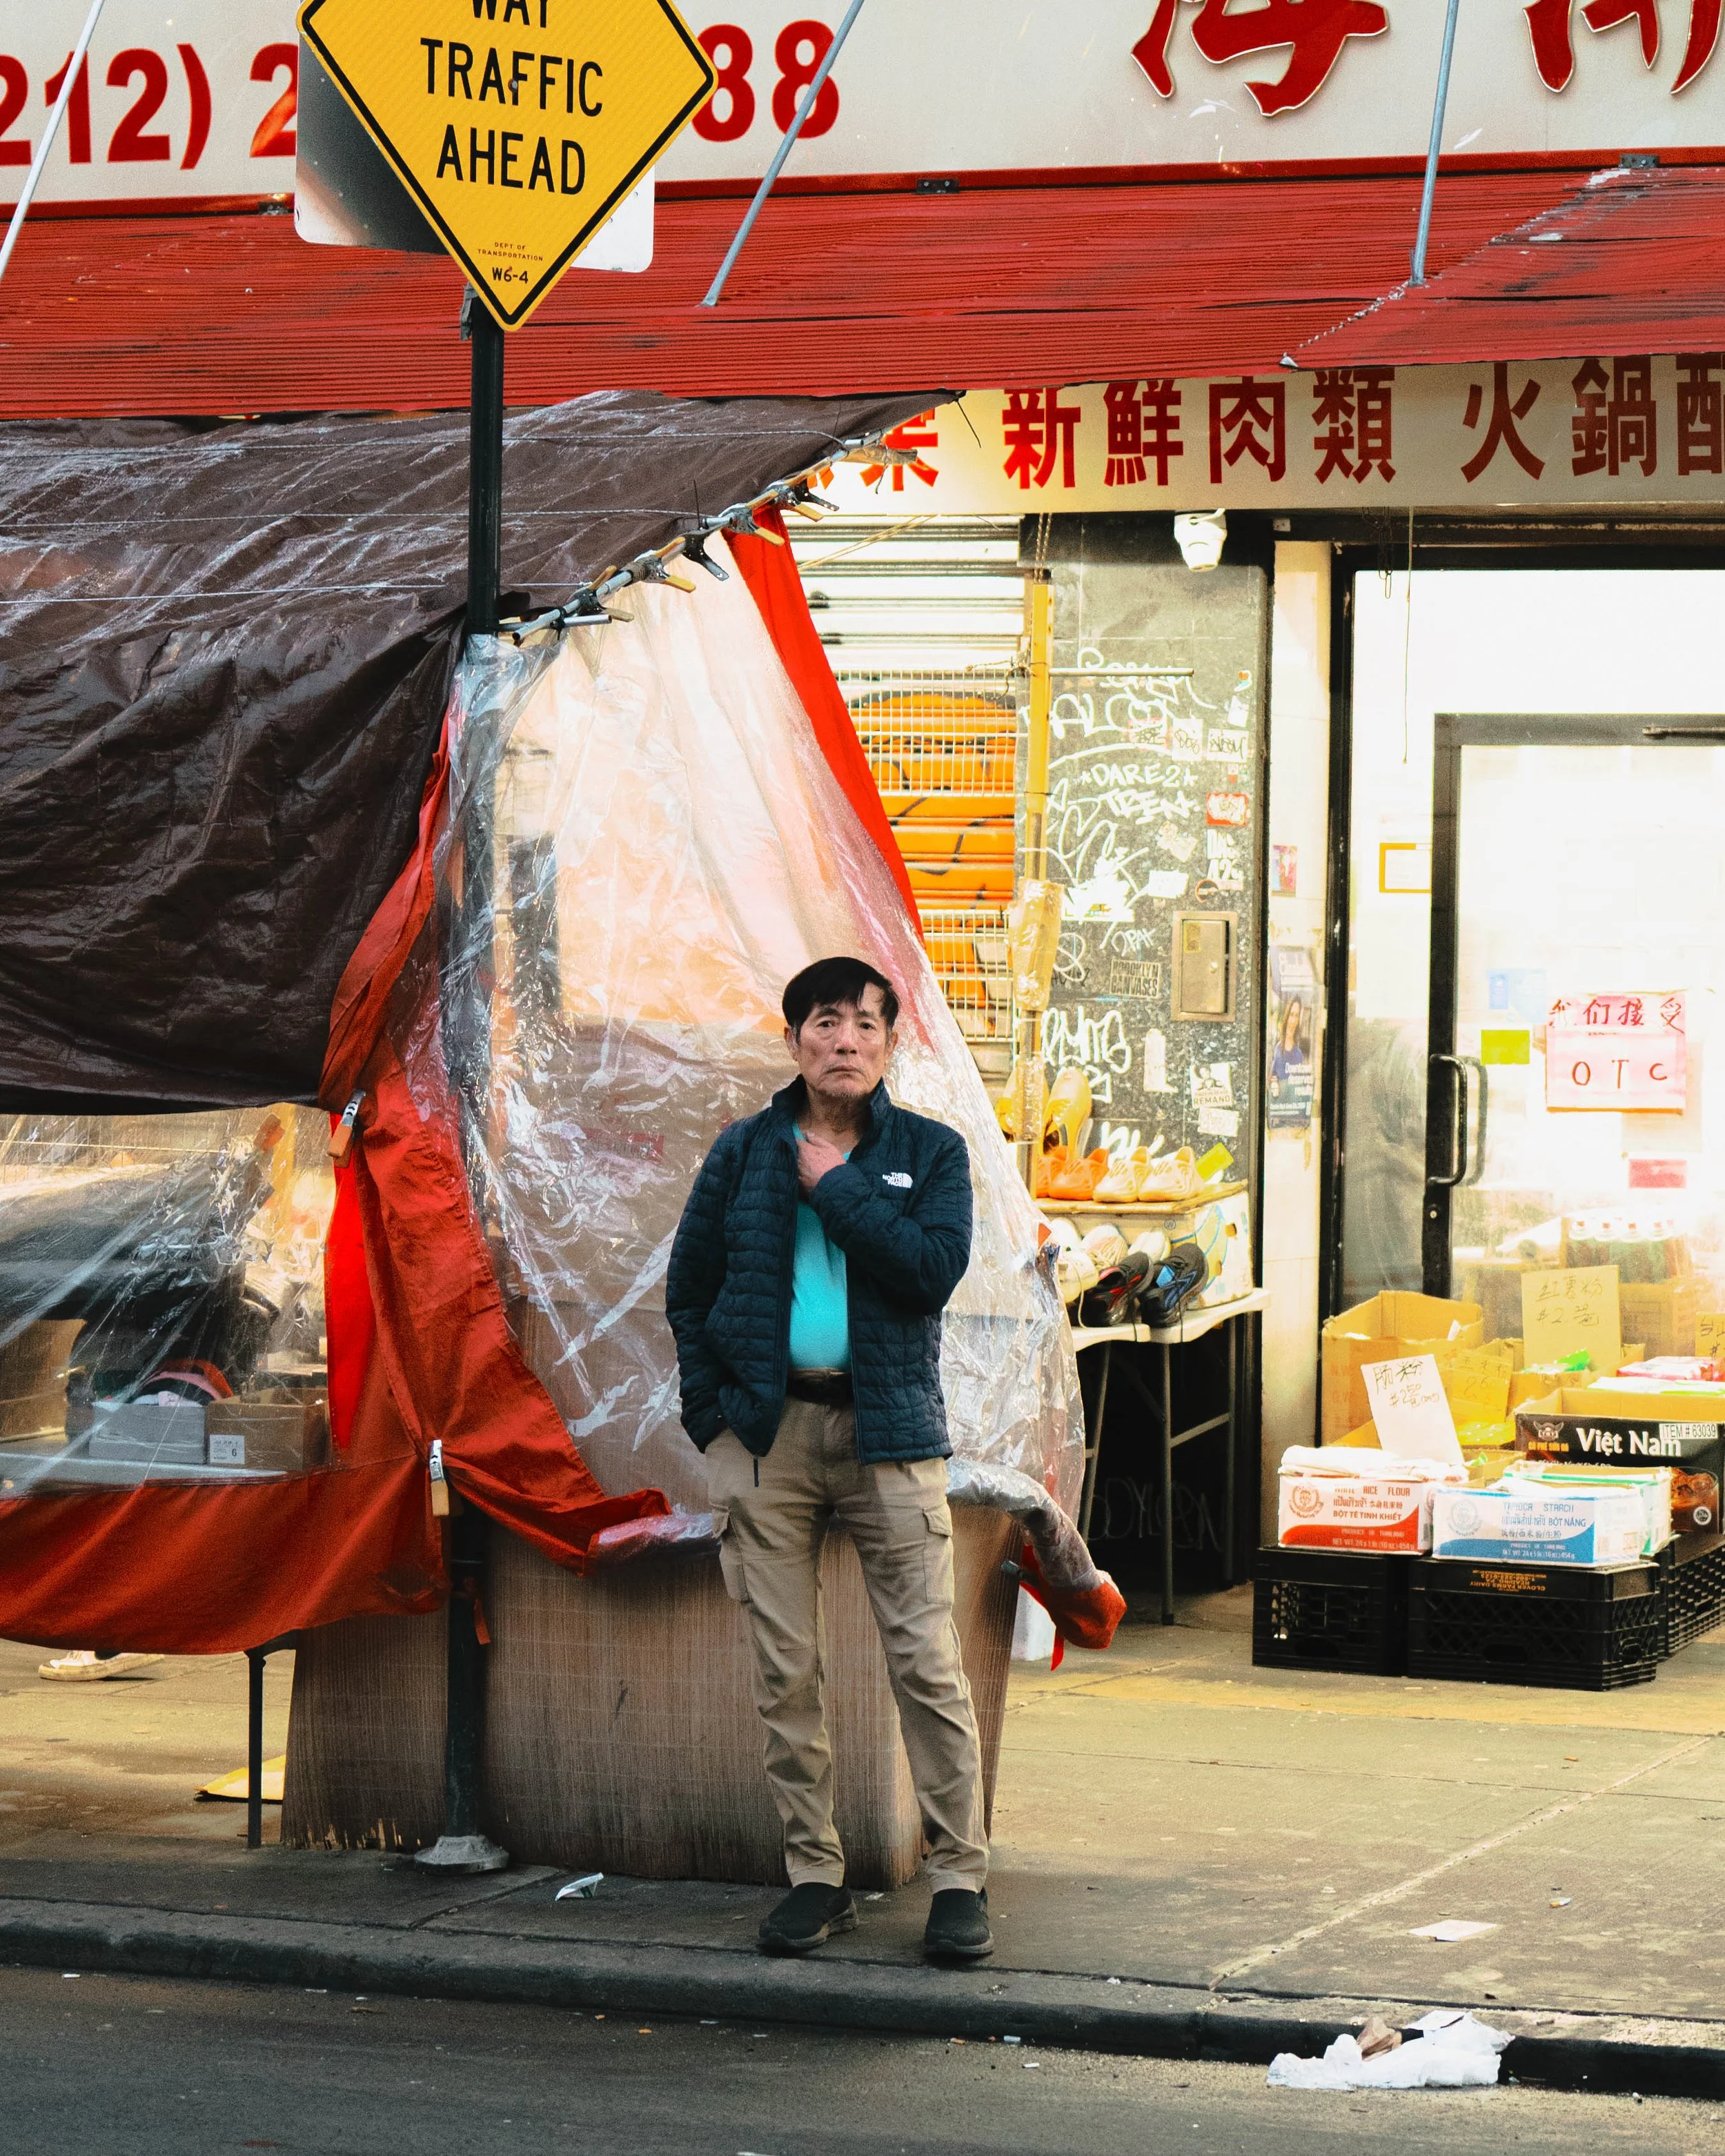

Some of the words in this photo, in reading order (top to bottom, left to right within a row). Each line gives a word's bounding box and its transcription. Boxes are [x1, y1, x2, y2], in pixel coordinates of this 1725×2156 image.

[420, 37, 603, 117] TRAFFIC
[436, 124, 585, 195] AHEAD
[477, 249, 543, 261] TRANSPORTATION
[492, 266, 529, 284] W6-4
[1002, 367, 1397, 489] 新鮮肉類
[1661, 1424, 1682, 1437] ITEM
[1693, 1424, 1717, 1438] 63039
[1576, 1427, 1623, 1456] Việt
[1628, 1430, 1682, 1456] Nam
[1363, 1486, 1378, 1495] RICE
[1388, 1487, 1410, 1496] FLOUR
[1544, 1503, 1574, 1512] STARCH
